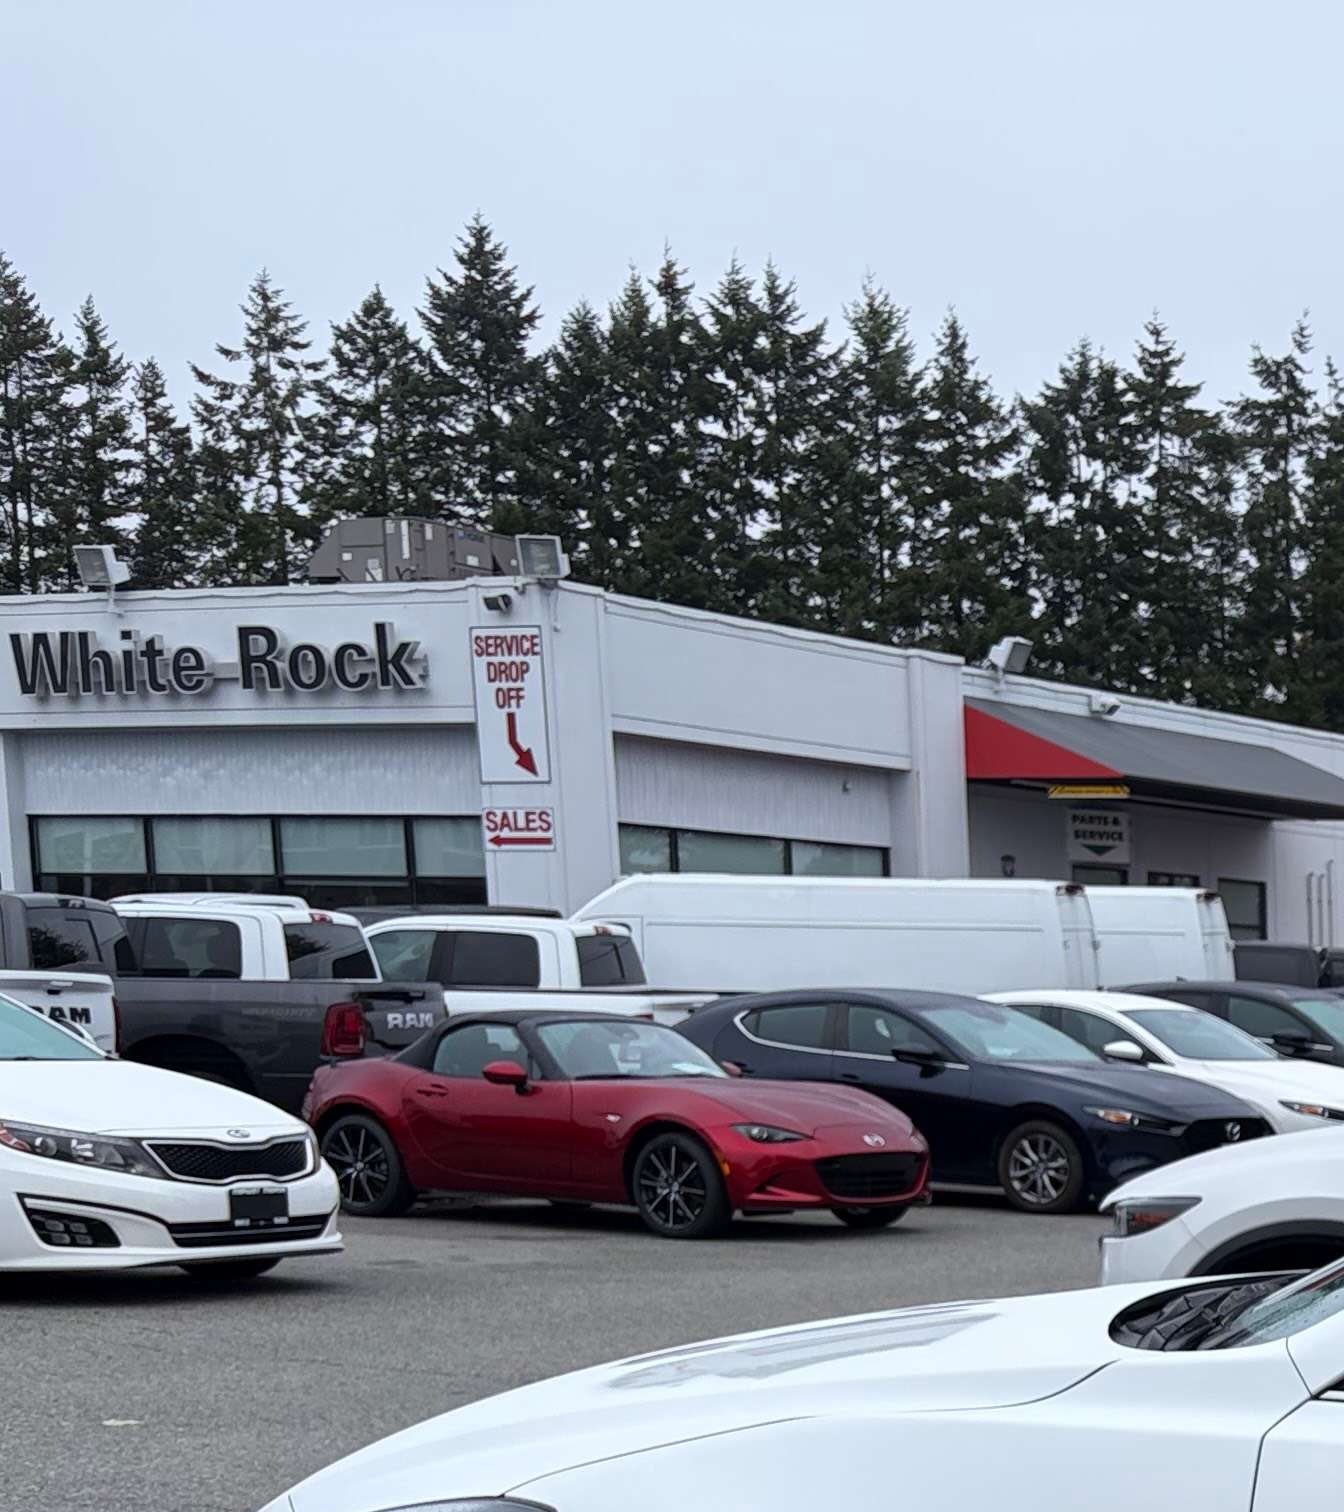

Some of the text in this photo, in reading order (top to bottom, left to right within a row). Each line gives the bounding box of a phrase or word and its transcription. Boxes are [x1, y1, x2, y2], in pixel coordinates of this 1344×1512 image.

[474, 634, 540, 656] SERVICE
[9, 622, 424, 695] White Rock
[486, 660, 530, 683] DROP
[495, 686, 525, 709] OFF
[485, 811, 552, 833] SALES
[1072, 813, 1109, 826] PARTS
[1074, 829, 1124, 842] SERVICE
[386, 1012, 434, 1030] RAM
